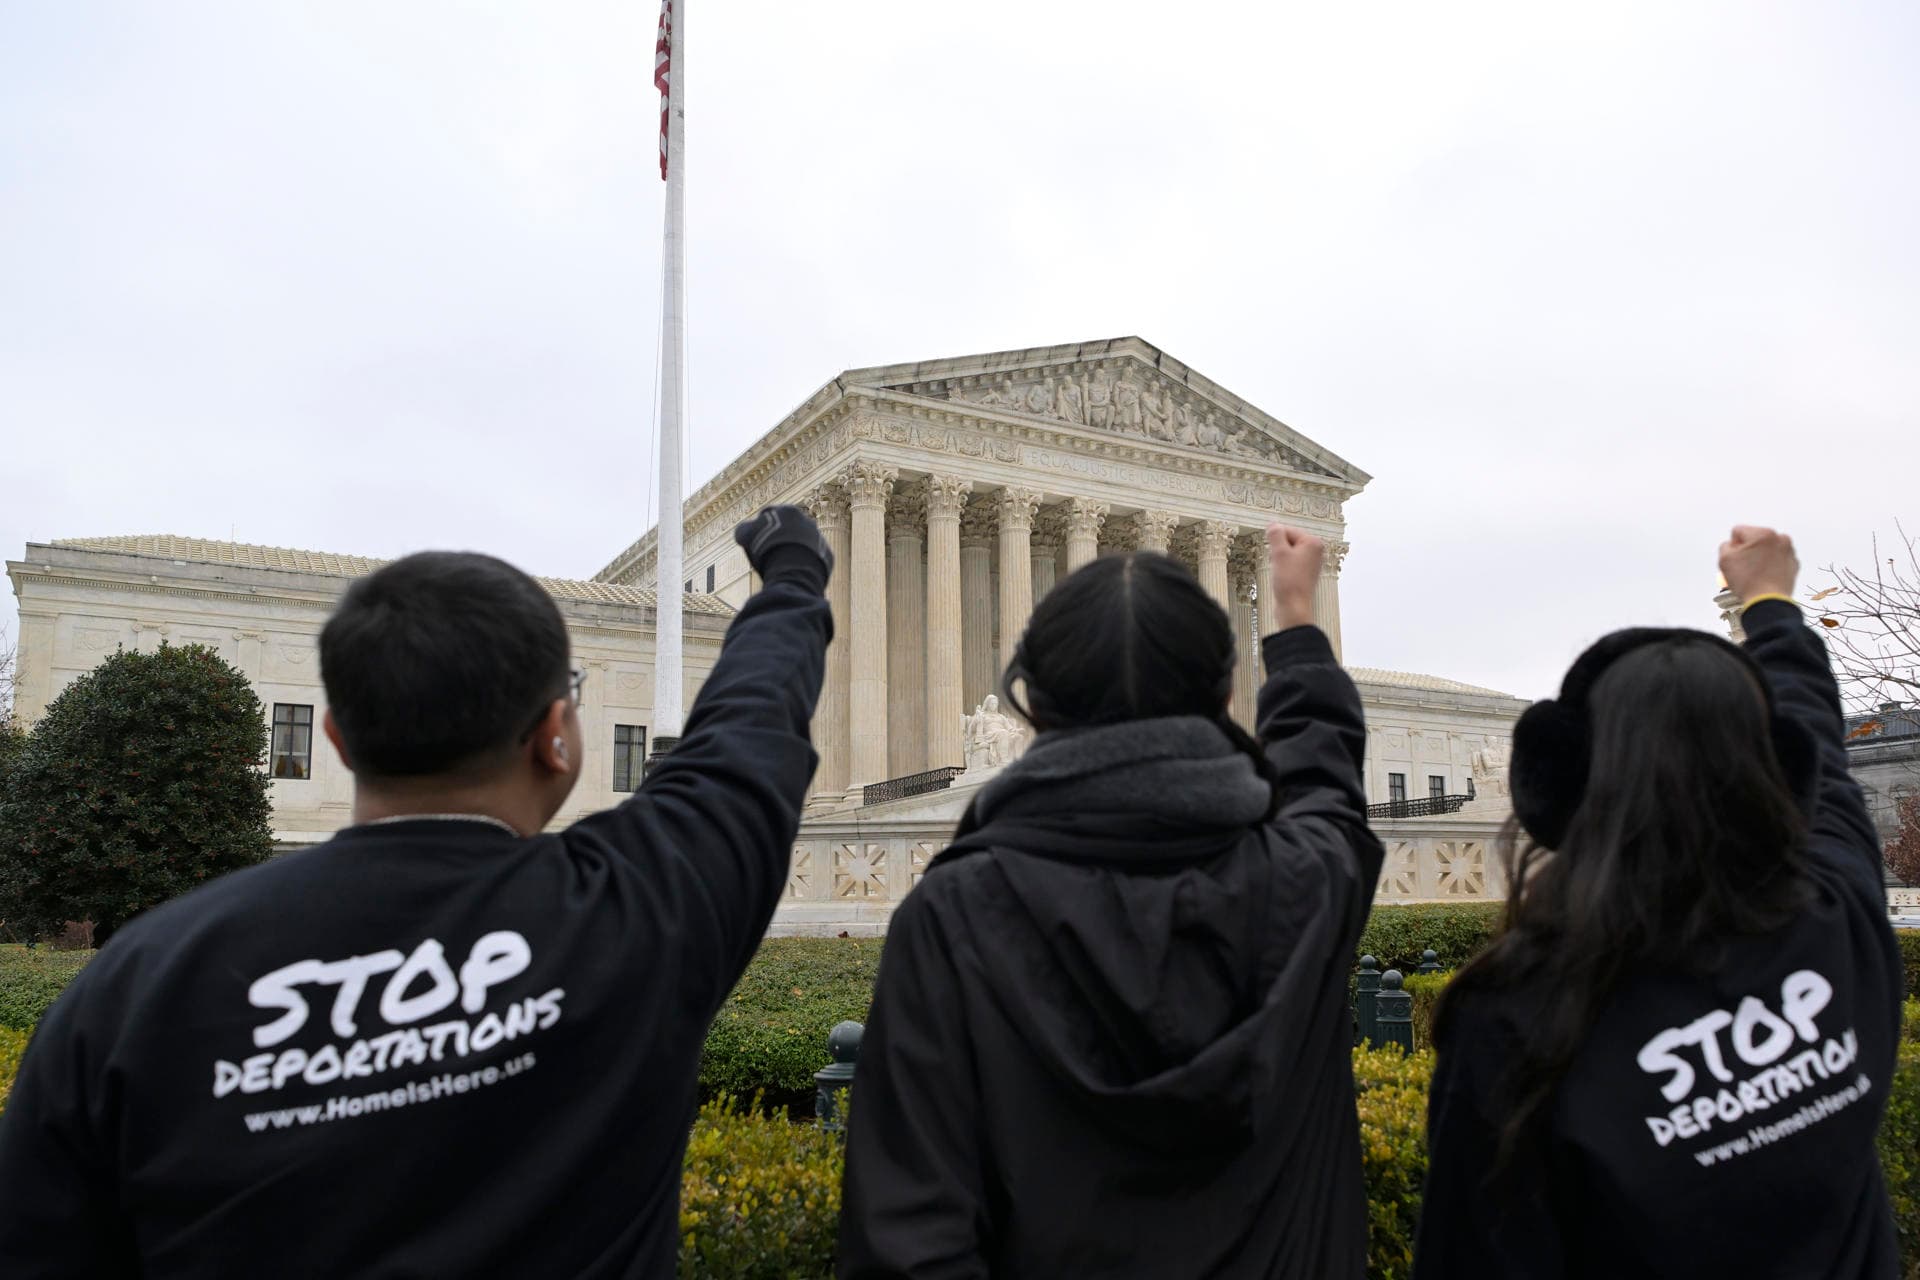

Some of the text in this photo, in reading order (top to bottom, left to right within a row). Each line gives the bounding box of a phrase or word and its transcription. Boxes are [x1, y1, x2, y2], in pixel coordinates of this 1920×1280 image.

[213, 988, 565, 1098] DEPORTATIONS
[248, 930, 532, 1048] STOP
[1637, 969, 1833, 1103] STOP
[244, 1052, 536, 1132] www.HomeIsHere.us
